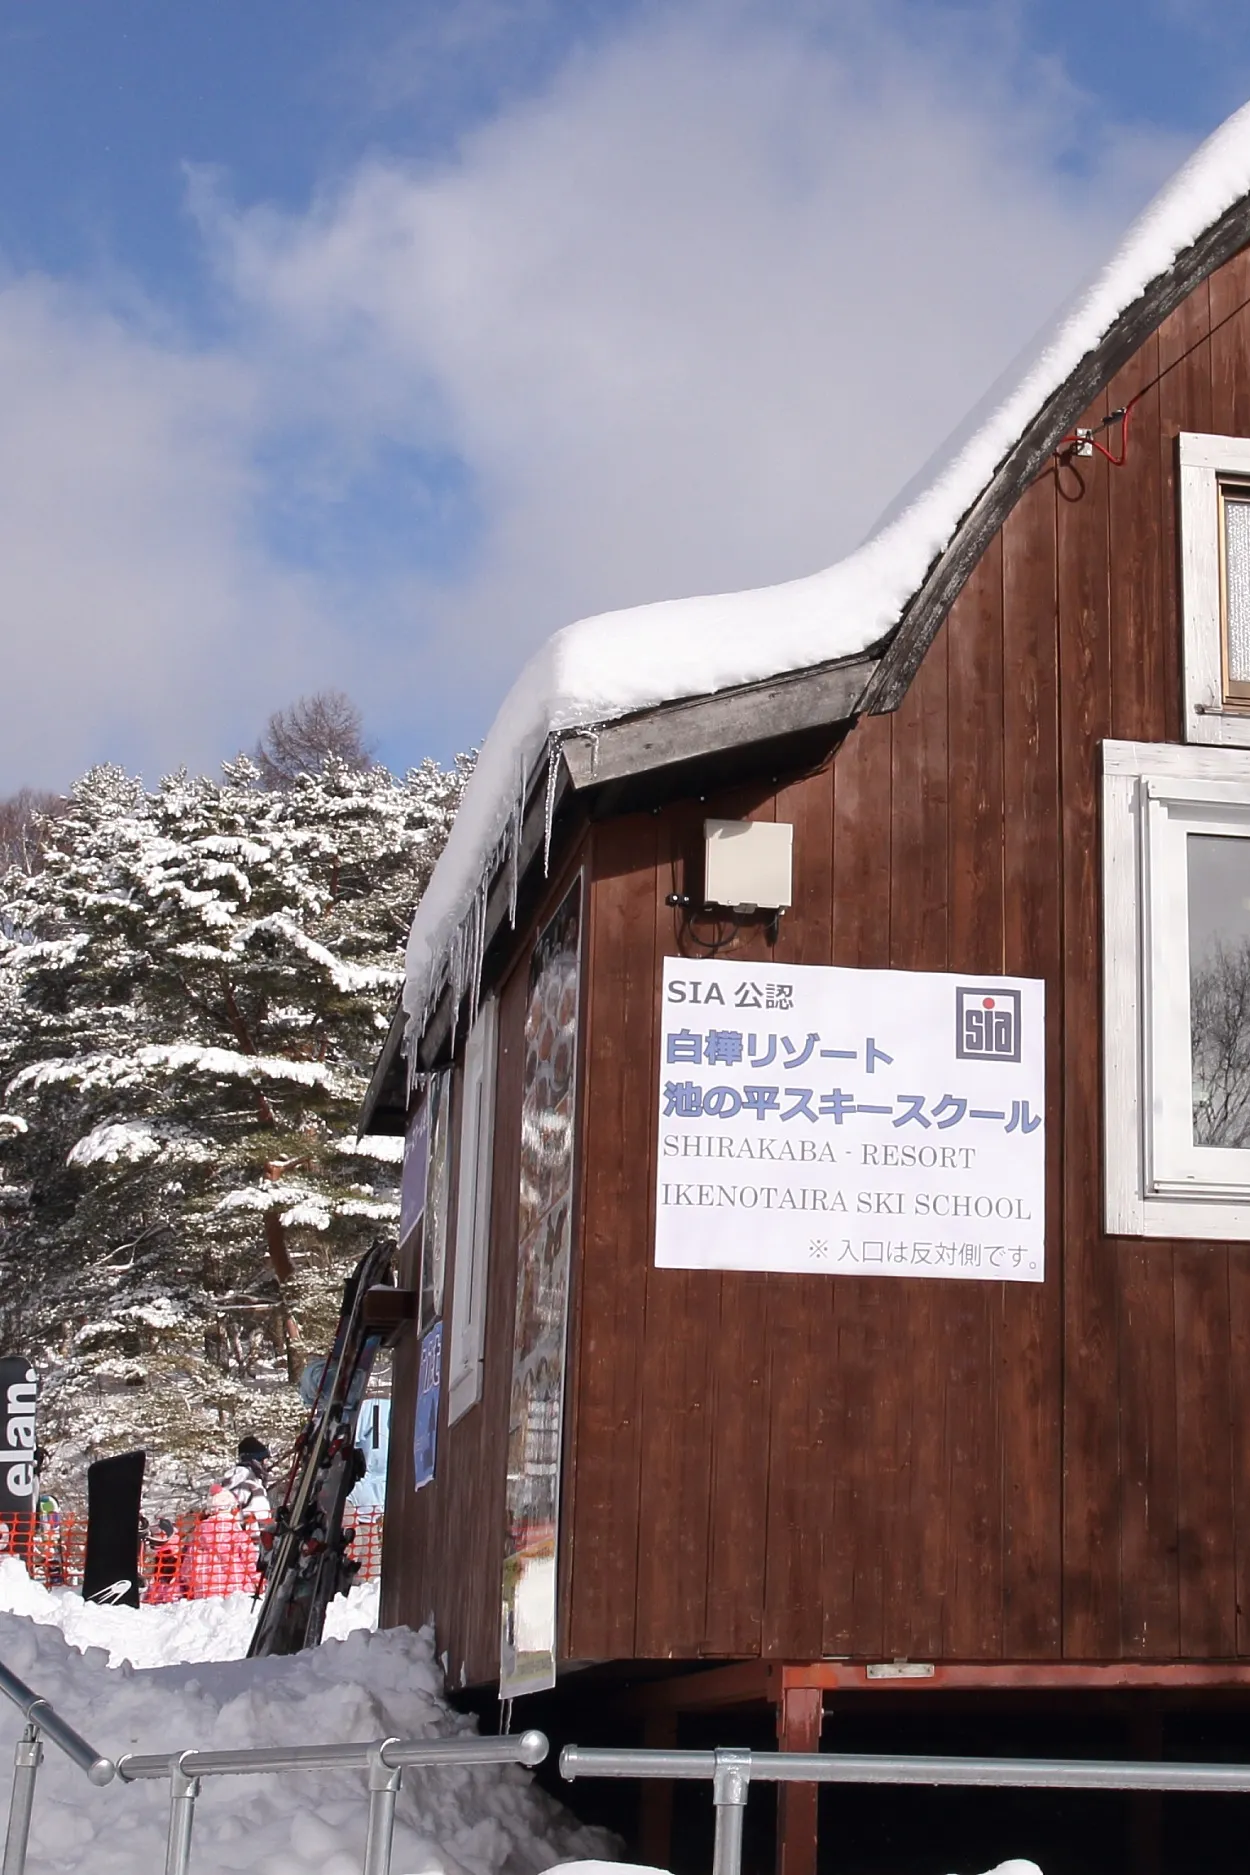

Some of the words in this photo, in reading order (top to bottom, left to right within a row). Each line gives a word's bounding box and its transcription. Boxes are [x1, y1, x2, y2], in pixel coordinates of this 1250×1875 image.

[667, 980, 726, 1005] SIA
[734, 981, 794, 1010] 公認
[666, 1028, 894, 1073] 白樺リゾート
[662, 1081, 1042, 1134] 池の平スキースクール
[662, 1135, 837, 1163] SHIRAKABA
[860, 1144, 976, 1169] RESORT
[661, 1183, 849, 1213] IKENOTAIRA
[856, 1192, 905, 1214] SKI
[914, 1194, 1032, 1220] SCHOOL
